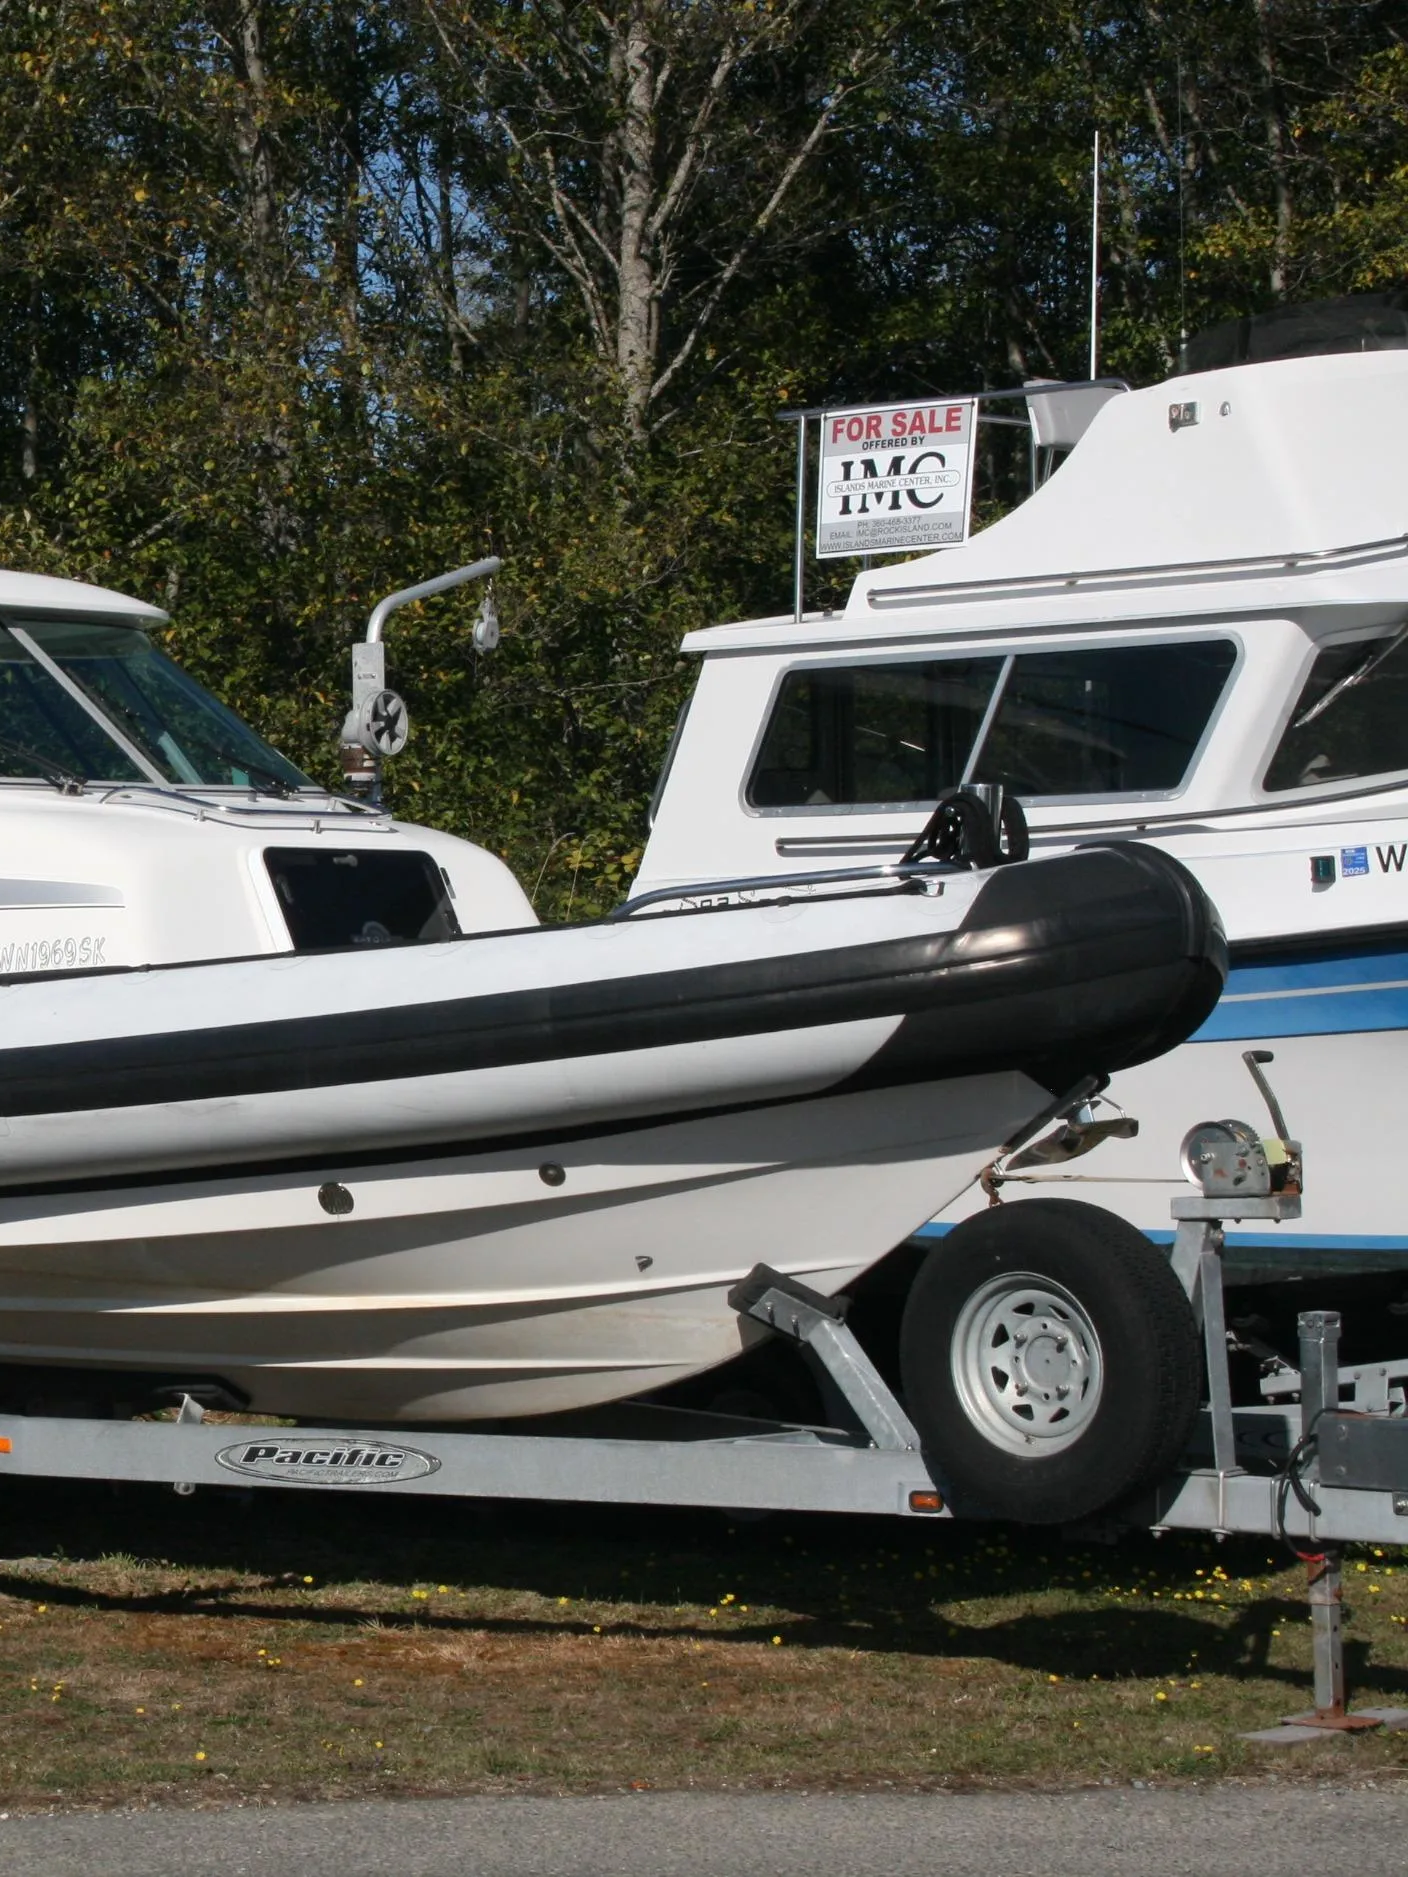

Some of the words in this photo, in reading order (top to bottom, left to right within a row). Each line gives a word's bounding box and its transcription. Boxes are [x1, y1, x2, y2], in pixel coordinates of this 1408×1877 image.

[832, 415, 882, 444] FOR
[891, 407, 962, 437] SALE
[862, 438, 908, 450] OFFERED
[911, 436, 925, 446] BY
[834, 482, 865, 494] ISLANDS
[867, 478, 897, 490] MARINE
[839, 451, 946, 515] IMC
[820, 533, 962, 550] WWW.ISLANDSMARINECENTER.COM
[1343, 866, 1366, 876] 2025
[241, 1445, 405, 1467] Pacific
